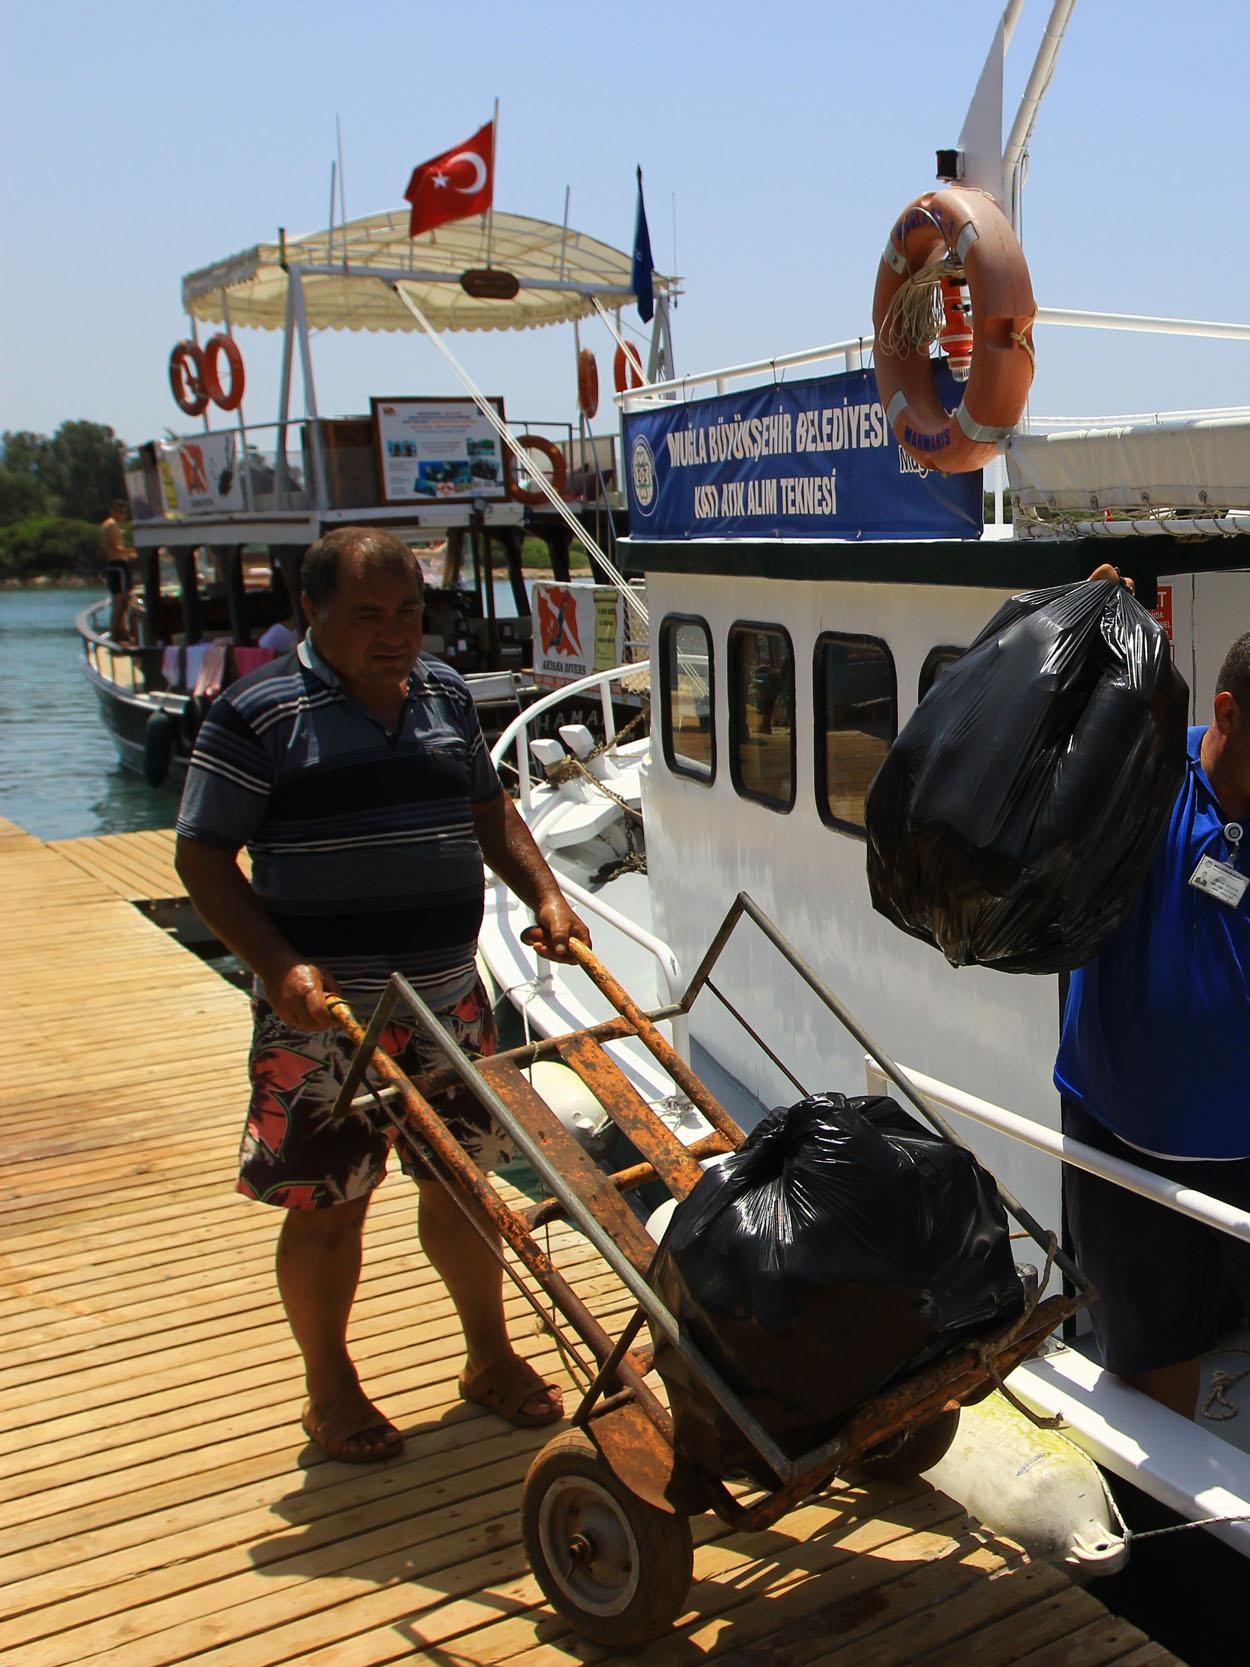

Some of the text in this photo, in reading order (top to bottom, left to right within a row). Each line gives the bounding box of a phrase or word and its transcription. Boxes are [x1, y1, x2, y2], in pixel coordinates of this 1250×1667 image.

[667, 423, 708, 468] MUĞLA
[709, 406, 792, 462] BÜYÜKŞEHİR
[694, 468, 837, 519] KATI ATIK ALIM TEKNESİ
